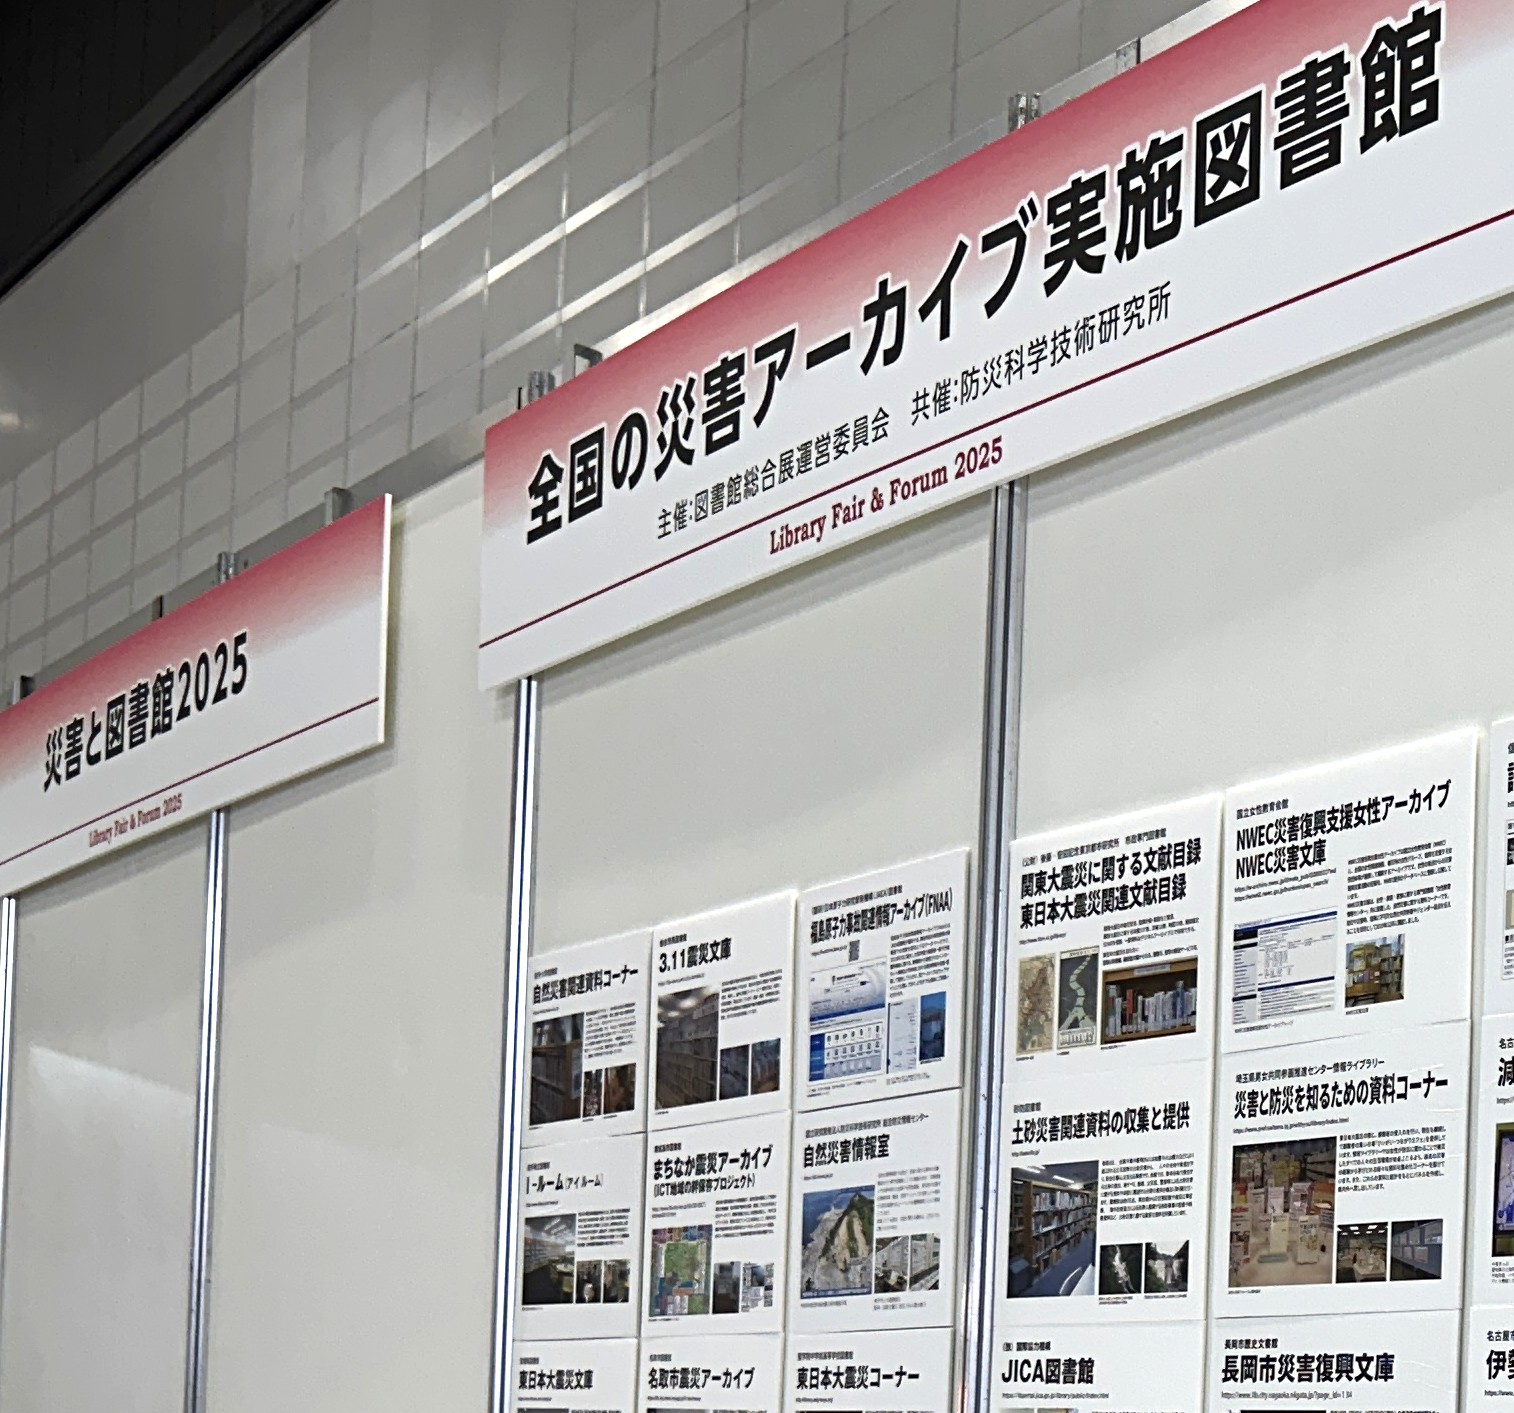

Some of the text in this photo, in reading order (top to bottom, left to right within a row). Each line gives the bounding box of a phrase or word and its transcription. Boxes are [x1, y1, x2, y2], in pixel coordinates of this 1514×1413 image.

[526, 4, 1445, 544] 全国の災害アーカイブ実施図書館
[658, 283, 1172, 539] 主催:図書館総合展運営委員会 共催:防災科学技術研究所
[770, 436, 1002, 555] Library Fair & Forum 2025
[44, 631, 247, 792] 災害と図書館2025
[1237, 779, 1451, 851] NWEC災害復興支援女性アーカイブ
[1021, 837, 1201, 899] 関東大震災に関する文献目録
[1236, 839, 1326, 879] NWEC災害文庫
[1021, 873, 1186, 929] 東日本大震災関連文献目録
[659, 937, 731, 973] 3.11震災文庫
[533, 964, 638, 1004] 自然災害関連資料コーナー
[1234, 1070, 1448, 1119] 災害と防災を知るための資料コーナー
[1012, 1101, 1190, 1145] 土砂災害関連資料の収集と提供
[653, 1144, 773, 1180] まちなか震災アーカイブ
[804, 1134, 890, 1168] 自然災害情報室
[519, 1369, 593, 1390] 東日本大震災文庫
[648, 1367, 755, 1389] 名取市震災アーカイブ
[797, 1366, 919, 1390] 東日本大震災コーナー
[1002, 1357, 1094, 1385] JICA図書館
[1222, 1353, 1394, 1383] 長岡市災害復興文庫
